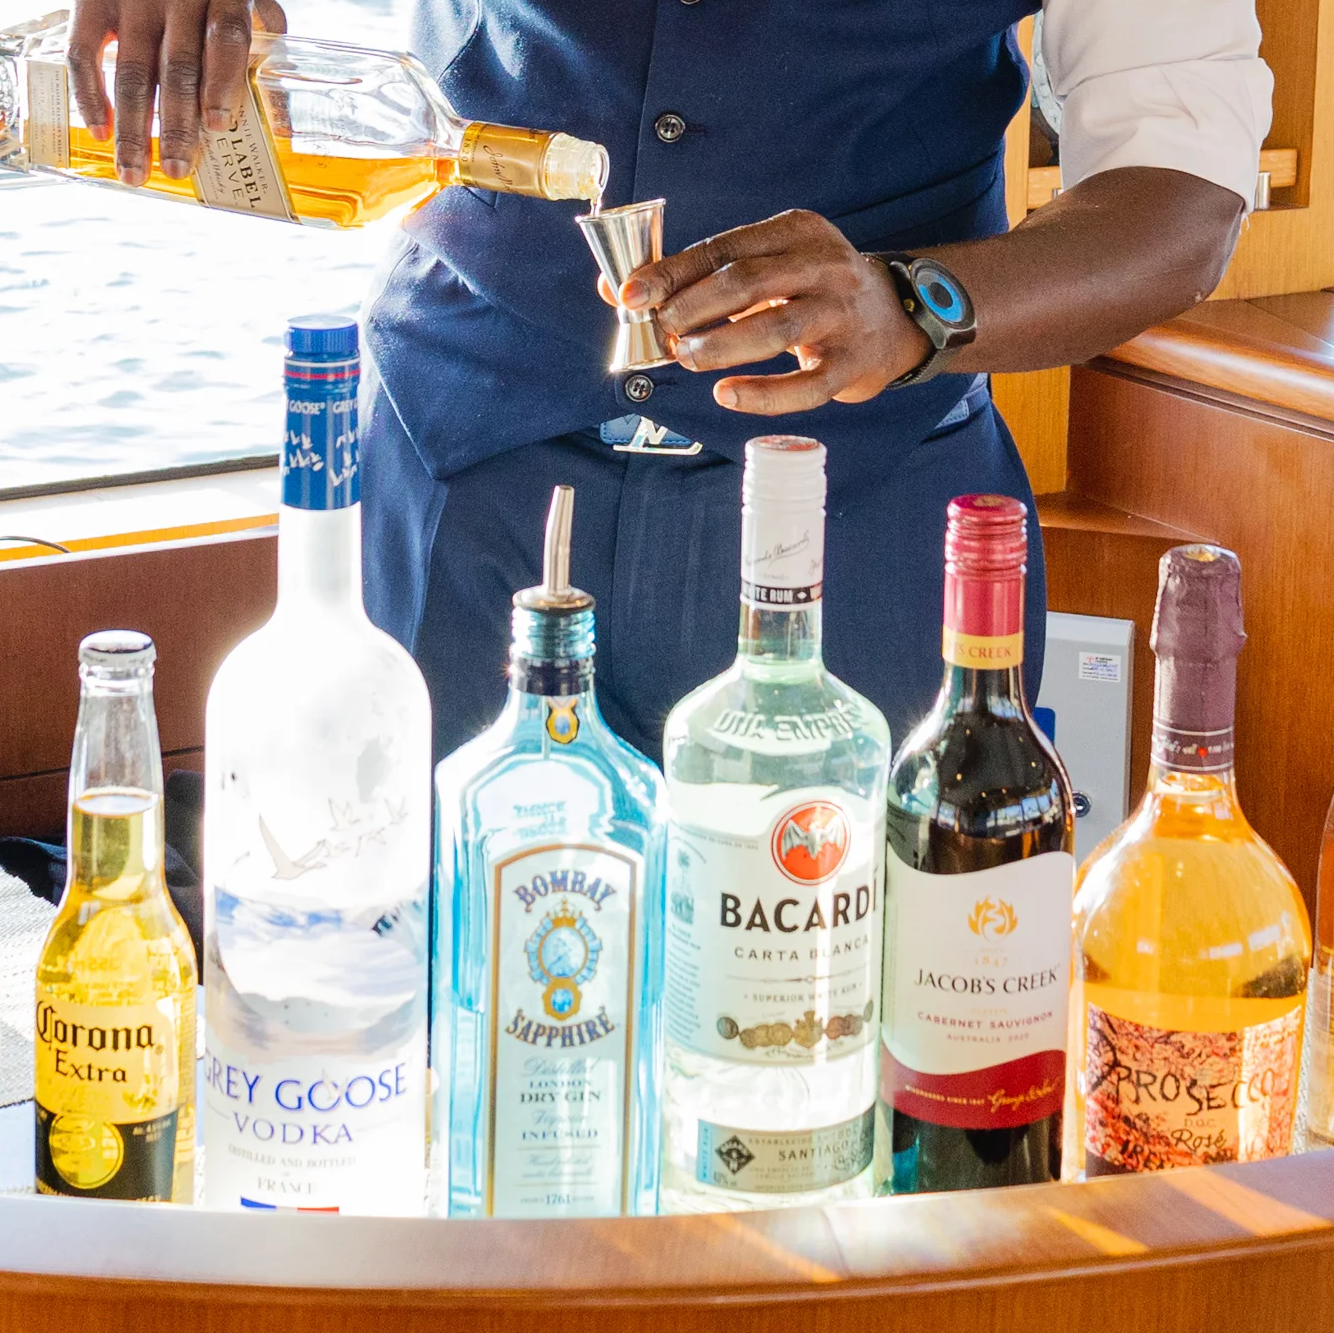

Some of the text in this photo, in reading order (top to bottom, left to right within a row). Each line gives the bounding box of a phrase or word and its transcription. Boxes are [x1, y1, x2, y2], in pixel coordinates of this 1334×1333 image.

[216, 136, 245, 201] ERVE
[230, 138, 262, 209] LABEL
[248, 142, 269, 192] WALKER
[769, 588, 794, 603] RUM
[968, 645, 1012, 659] CREEK
[512, 869, 617, 914] BOMBAY
[734, 946, 800, 962] CARTA
[913, 968, 1058, 995] JACOB'S CREEK
[752, 993, 804, 1003] SUPERIOR
[36, 1000, 156, 1052] Corona
[505, 1005, 616, 1048] SAPPHIRE
[917, 1010, 1054, 1030] CABERNET SAUVIGNON
[946, 1033, 1002, 1043] AUSTRALIA
[55, 1048, 128, 1083] Extra
[274, 1062, 408, 1112] GOOSE
[529, 1078, 592, 1089] LONDON
[1113, 1064, 1276, 1116] PROSECCO
[520, 1091, 602, 1104] DRY GIN
[233, 1111, 354, 1146] VODKA
[521, 1129, 599, 1141] INFUSED
[1170, 1128, 1228, 1152] Rosé
[228, 1143, 357, 1169] DISTILLED AND BOTTLED
[778, 1140, 849, 1162] SANTIAGO
[545, 1193, 572, 1206] 1761
